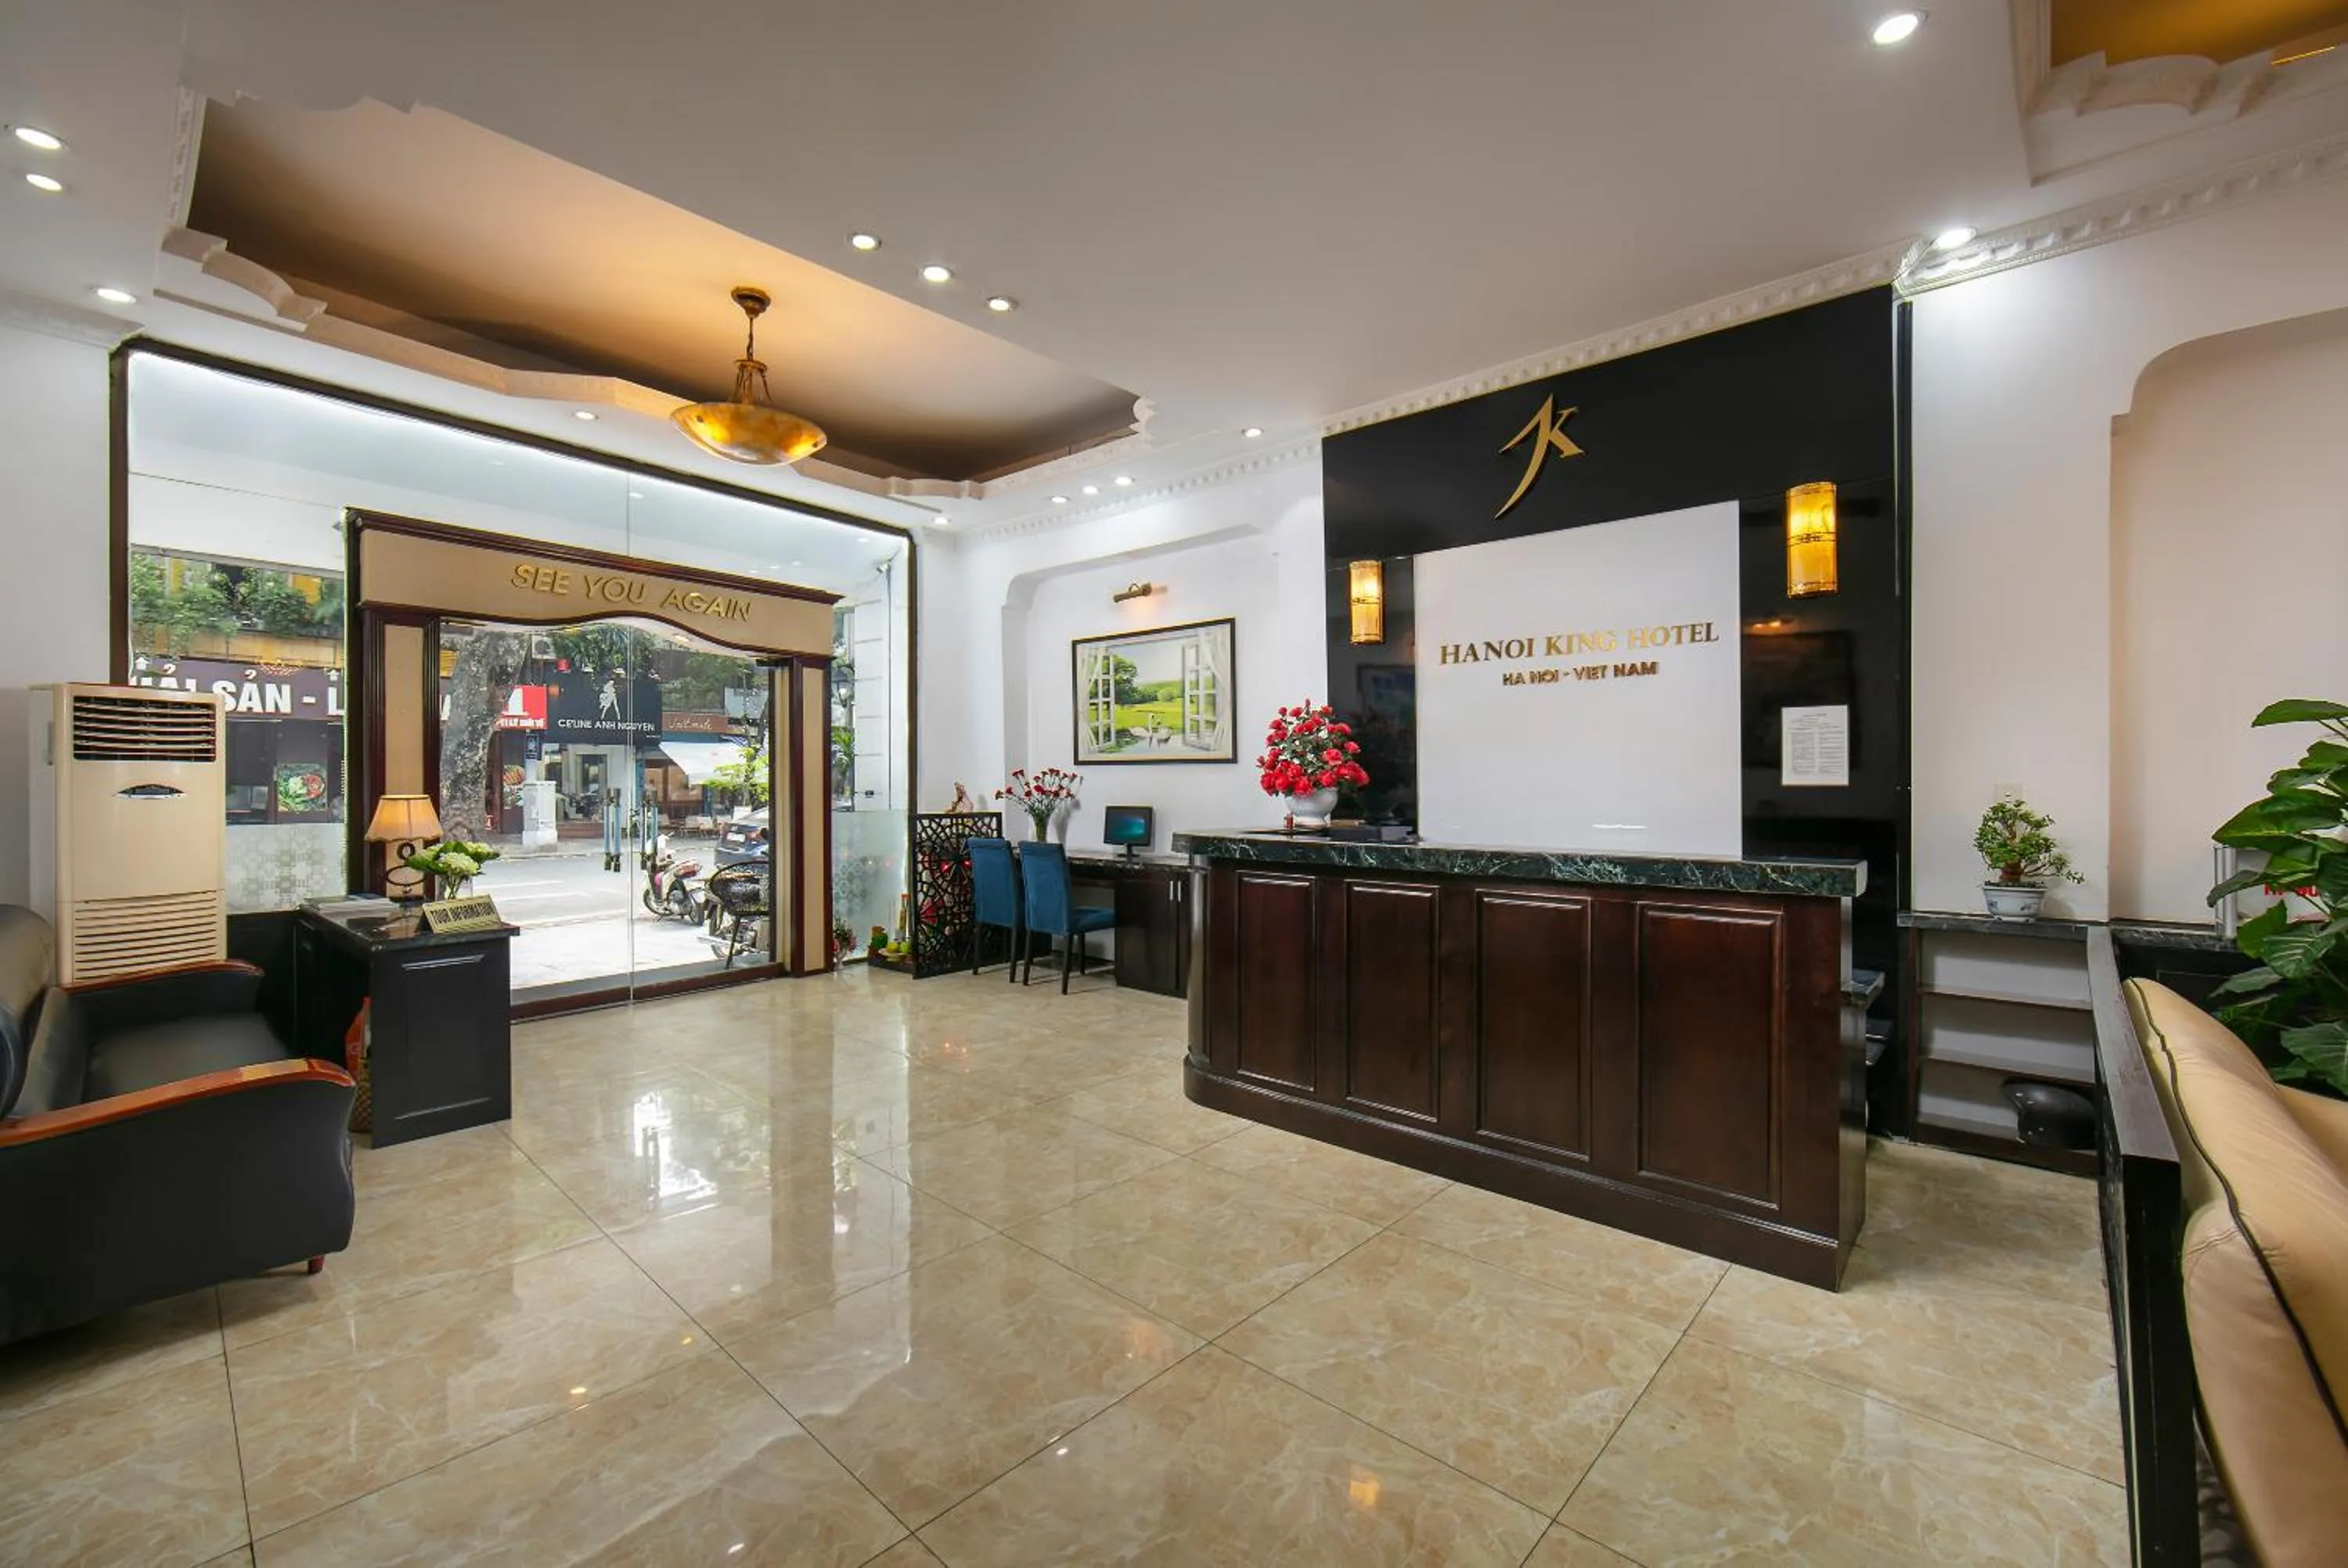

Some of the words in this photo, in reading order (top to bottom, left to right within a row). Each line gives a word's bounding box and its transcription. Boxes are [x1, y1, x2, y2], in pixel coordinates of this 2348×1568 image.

[511, 563, 571, 595] SEE
[583, 575, 646, 604] YOU
[660, 588, 751, 621] AGAIN
[1439, 637, 1535, 665] HANOI
[1544, 629, 1617, 656] KING
[1627, 622, 1720, 650] HOTEL
[212, 669, 292, 714] SẢN
[1502, 672, 1526, 686] HA
[1529, 669, 1560, 684] NOI
[1572, 665, 1608, 681] VIET
[1613, 661, 1659, 678] NAM
[595, 721, 616, 730] ANH
